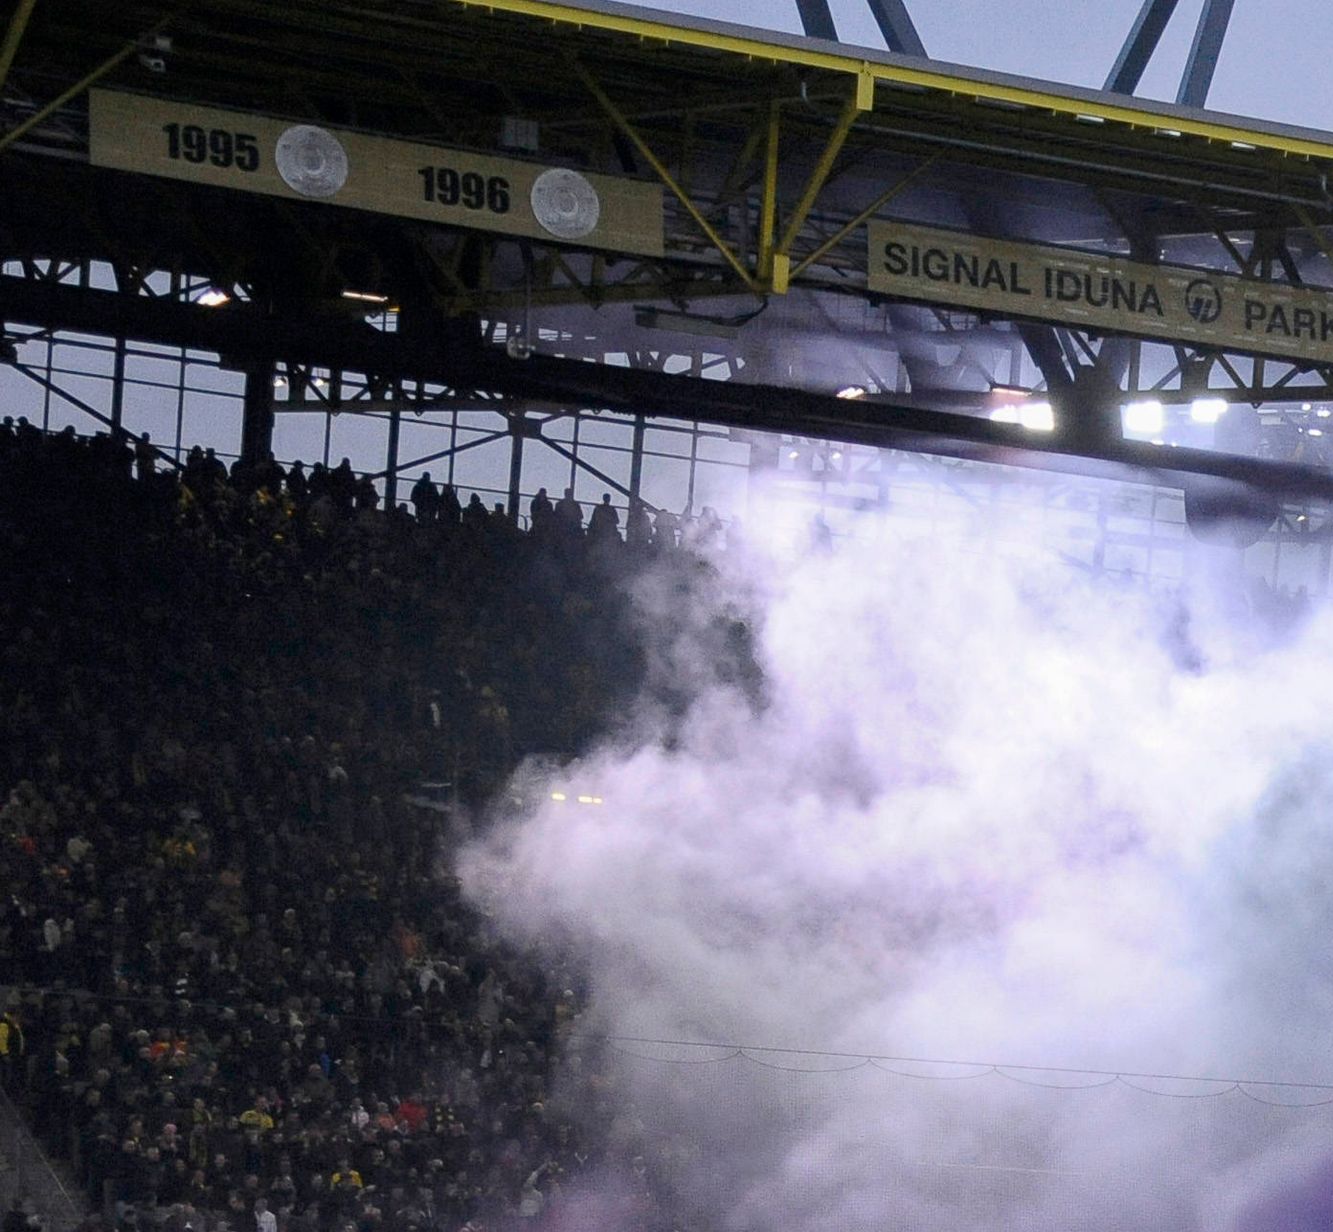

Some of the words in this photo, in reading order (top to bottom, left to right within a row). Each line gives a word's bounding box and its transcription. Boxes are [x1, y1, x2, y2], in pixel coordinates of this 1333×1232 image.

[162, 122, 260, 172] 1995
[418, 166, 510, 214] 1996
[883, 242, 1031, 296] SIGNAL
[1044, 269, 1165, 317] IDUNA
